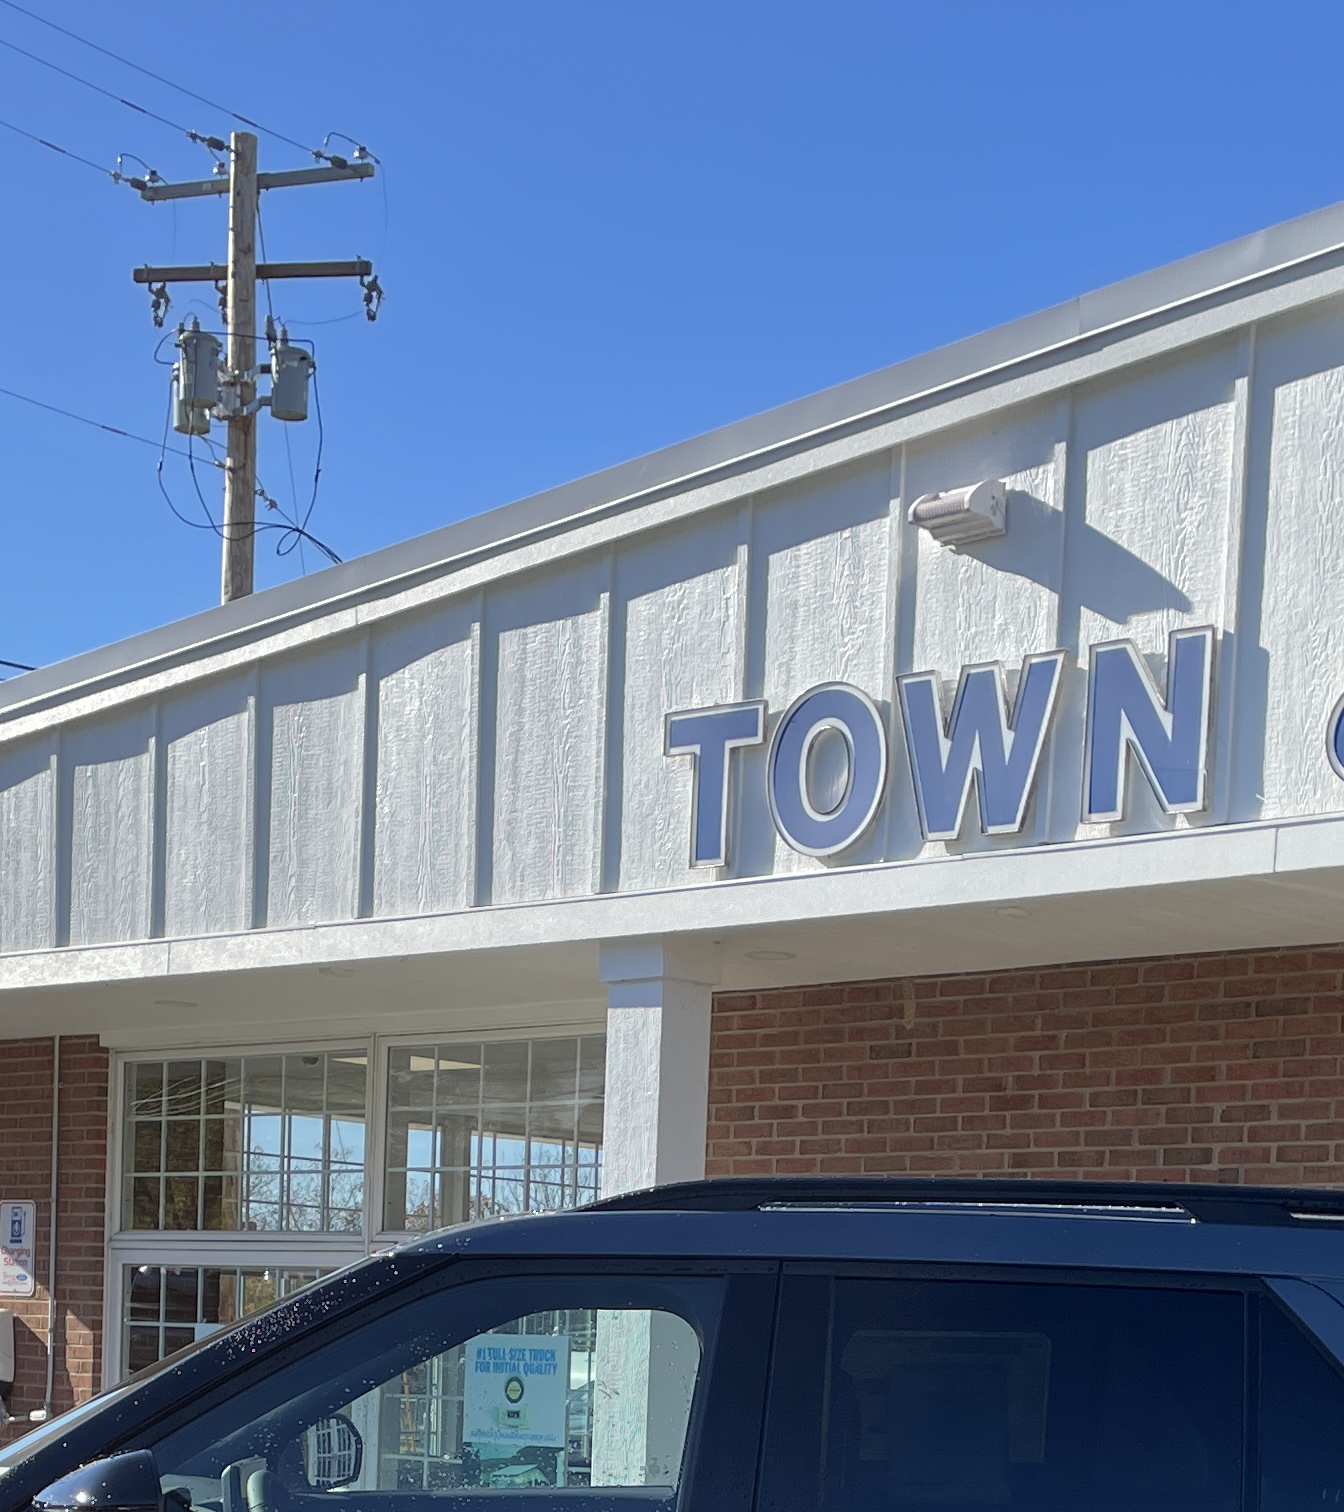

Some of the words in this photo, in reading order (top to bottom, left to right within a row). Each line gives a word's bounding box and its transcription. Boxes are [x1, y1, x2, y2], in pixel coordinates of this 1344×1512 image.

[663, 624, 1217, 869] TOWN
[1, 1245, 30, 1258] Charging
[3, 1257, 28, 1266] Station
[529, 1348, 556, 1362] TRUCK
[475, 1361, 490, 1373] FOR
[492, 1361, 521, 1374] INITIAL
[523, 1362, 558, 1377] QUALITY
